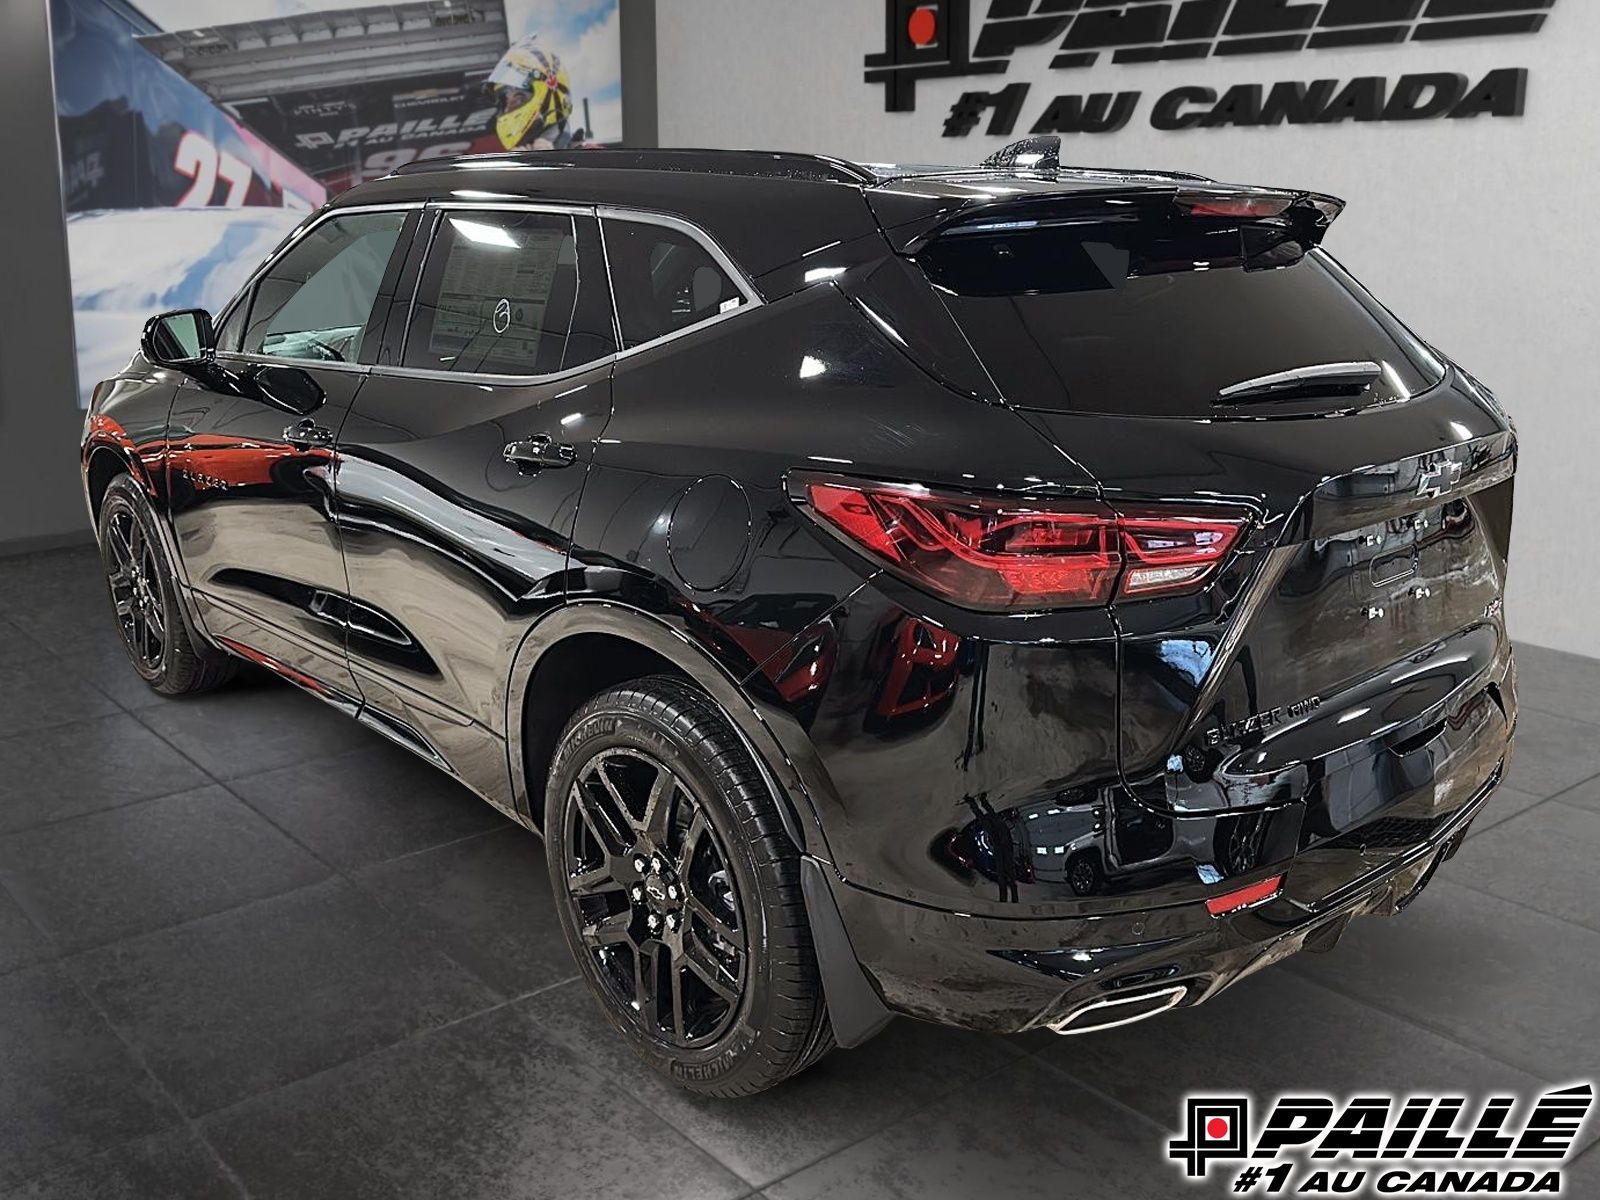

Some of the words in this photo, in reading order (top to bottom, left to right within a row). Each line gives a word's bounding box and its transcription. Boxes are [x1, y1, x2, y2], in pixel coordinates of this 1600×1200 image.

[941, 82, 1031, 137] #1
[1028, 91, 1141, 134] AU
[1150, 67, 1528, 130] CANADA
[174, 130, 252, 208] 27
